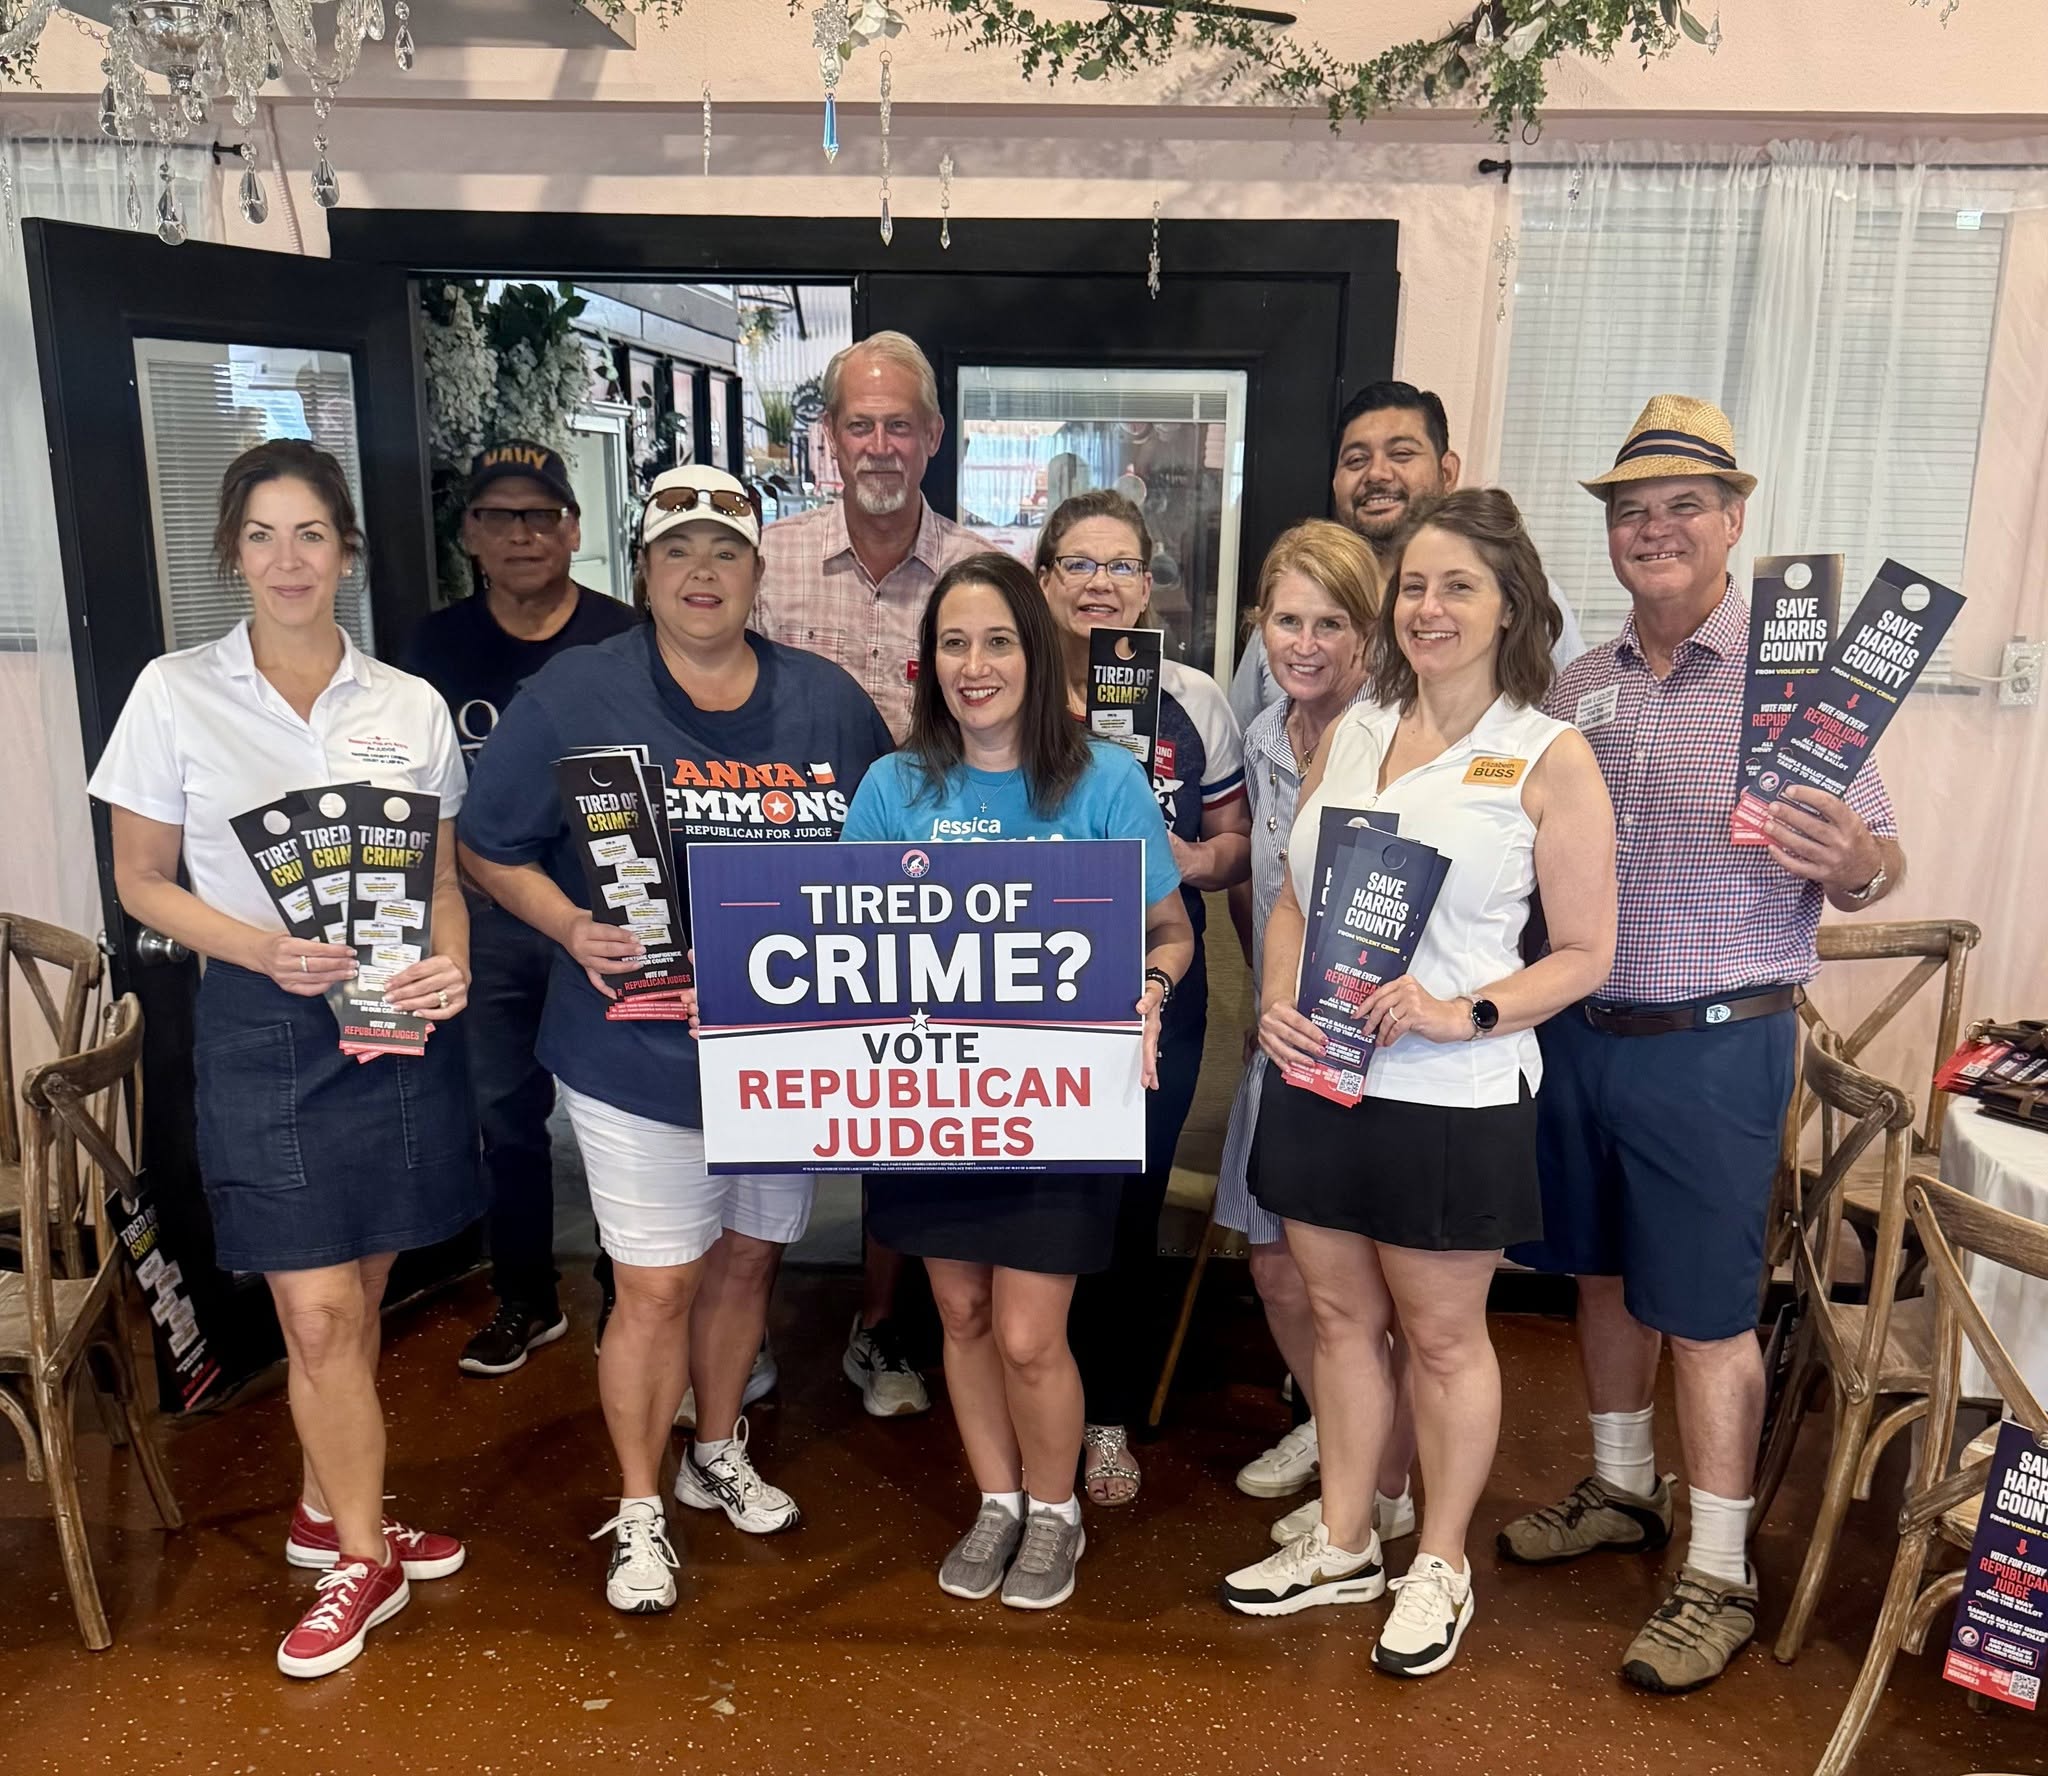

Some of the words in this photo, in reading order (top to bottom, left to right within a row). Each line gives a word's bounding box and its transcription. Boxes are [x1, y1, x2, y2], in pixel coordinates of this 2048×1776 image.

[1775, 597, 1819, 619] SAVE
[1763, 619, 1828, 641] HARRIS
[1877, 610, 1924, 645] SAVE
[1759, 641, 1829, 662] COUNTY
[1855, 624, 1920, 669] HARRIS
[1093, 665, 1134, 686] TIRED
[1136, 668, 1155, 687] OF
[1841, 644, 1911, 689] COUNTY
[1097, 684, 1149, 705] CRIME?
[1830, 665, 1850, 679] FROM
[1850, 675, 1877, 693] VIOLENT
[1876, 689, 1898, 704] CRIME
[1752, 713, 1791, 727] REPUB
[1760, 704, 1778, 713] VOTE
[1778, 704, 1792, 713] FOR
[1817, 701, 1836, 715] VOTE
[1833, 709, 1849, 722] FOR
[1845, 716, 1870, 732] EVERY
[1803, 706, 1869, 749] REPUBLICAN
[1810, 727, 1846, 753] JUDGE
[1790, 738, 1812, 752] DOWN
[1811, 748, 1825, 759] THE
[1823, 754, 1849, 771] BALLOT
[1802, 737, 1814, 747] ALL
[1814, 743, 1828, 754] THE
[1827, 749, 1844, 761] WAY
[672, 758, 808, 789] ANNA
[1473, 767, 1516, 778] BUSS
[1801, 763, 1827, 780] BALLOT
[1820, 781, 1842, 796] POLLS
[575, 793, 620, 815] TIRED
[620, 792, 638, 810] OF
[586, 810, 640, 833] CRIME?
[685, 825, 763, 840] REPUBLICAN
[765, 828, 791, 840] FOR
[793, 827, 832, 838] JUDGE
[930, 816, 1001, 840] Jessica
[300, 824, 352, 850] TIRED
[357, 825, 407, 848] TIRED
[409, 830, 432, 851] OF
[362, 845, 425, 869] CRIME?
[1366, 871, 1407, 900] SAVE
[800, 884, 953, 925] TIRED
[965, 882, 1033, 923] OF
[1351, 888, 1410, 921] HARRIS
[1344, 906, 1406, 941] COUNTY
[1355, 935, 1381, 947] VIOLENT
[747, 931, 1092, 1005] CRIME?
[1334, 962, 1350, 974] VOTE
[1349, 966, 1362, 977] FOR
[1361, 971, 1382, 984] EVERY
[624, 977, 666, 991] REPUBLICAN
[666, 974, 691, 985] JUDGES
[1324, 968, 1377, 994] REPUBLICA
[1334, 986, 1366, 1005] JUDGE
[344, 1025, 391, 1038] REPUBLICAN
[391, 1029, 420, 1040] JUDGES
[1333, 1019, 1356, 1031] BALLOT
[862, 1032, 980, 1065] VOTE
[738, 1067, 1091, 1110] REPUBLICAN
[812, 1117, 1035, 1158] JUDGES
[120, 1214, 148, 1247] TIRED
[1989, 1513, 2011, 1526] FROM
[2010, 1520, 2042, 1537] VIOLENT
[1979, 1557, 2048, 1593] REPUBLICAN
[1990, 1550, 2009, 1564] VOTE
[2007, 1556, 2024, 1568] FOR
[2022, 1562, 2048, 1577] EVERY
[1986, 1588, 2001, 1597] ALL
[2000, 1592, 2015, 1603] THE
[2015, 1598, 2034, 1609] WAY
[1992, 1576, 2031, 1600] JUDGE
[1975, 1590, 1999, 1603] DOWN
[1999, 1599, 2014, 1609] THE
[2013, 1604, 2044, 1618] BALLOT
[1967, 1605, 1995, 1620] SAMPLE
[1995, 1616, 2024, 1630] BALLOT
[1968, 1612, 1987, 1624] TAKE
[1986, 1618, 1995, 1626] IT
[1995, 1622, 2007, 1631] TO
[2006, 1626, 2022, 1635] THE
[2021, 1630, 2046, 1644] POLLS
